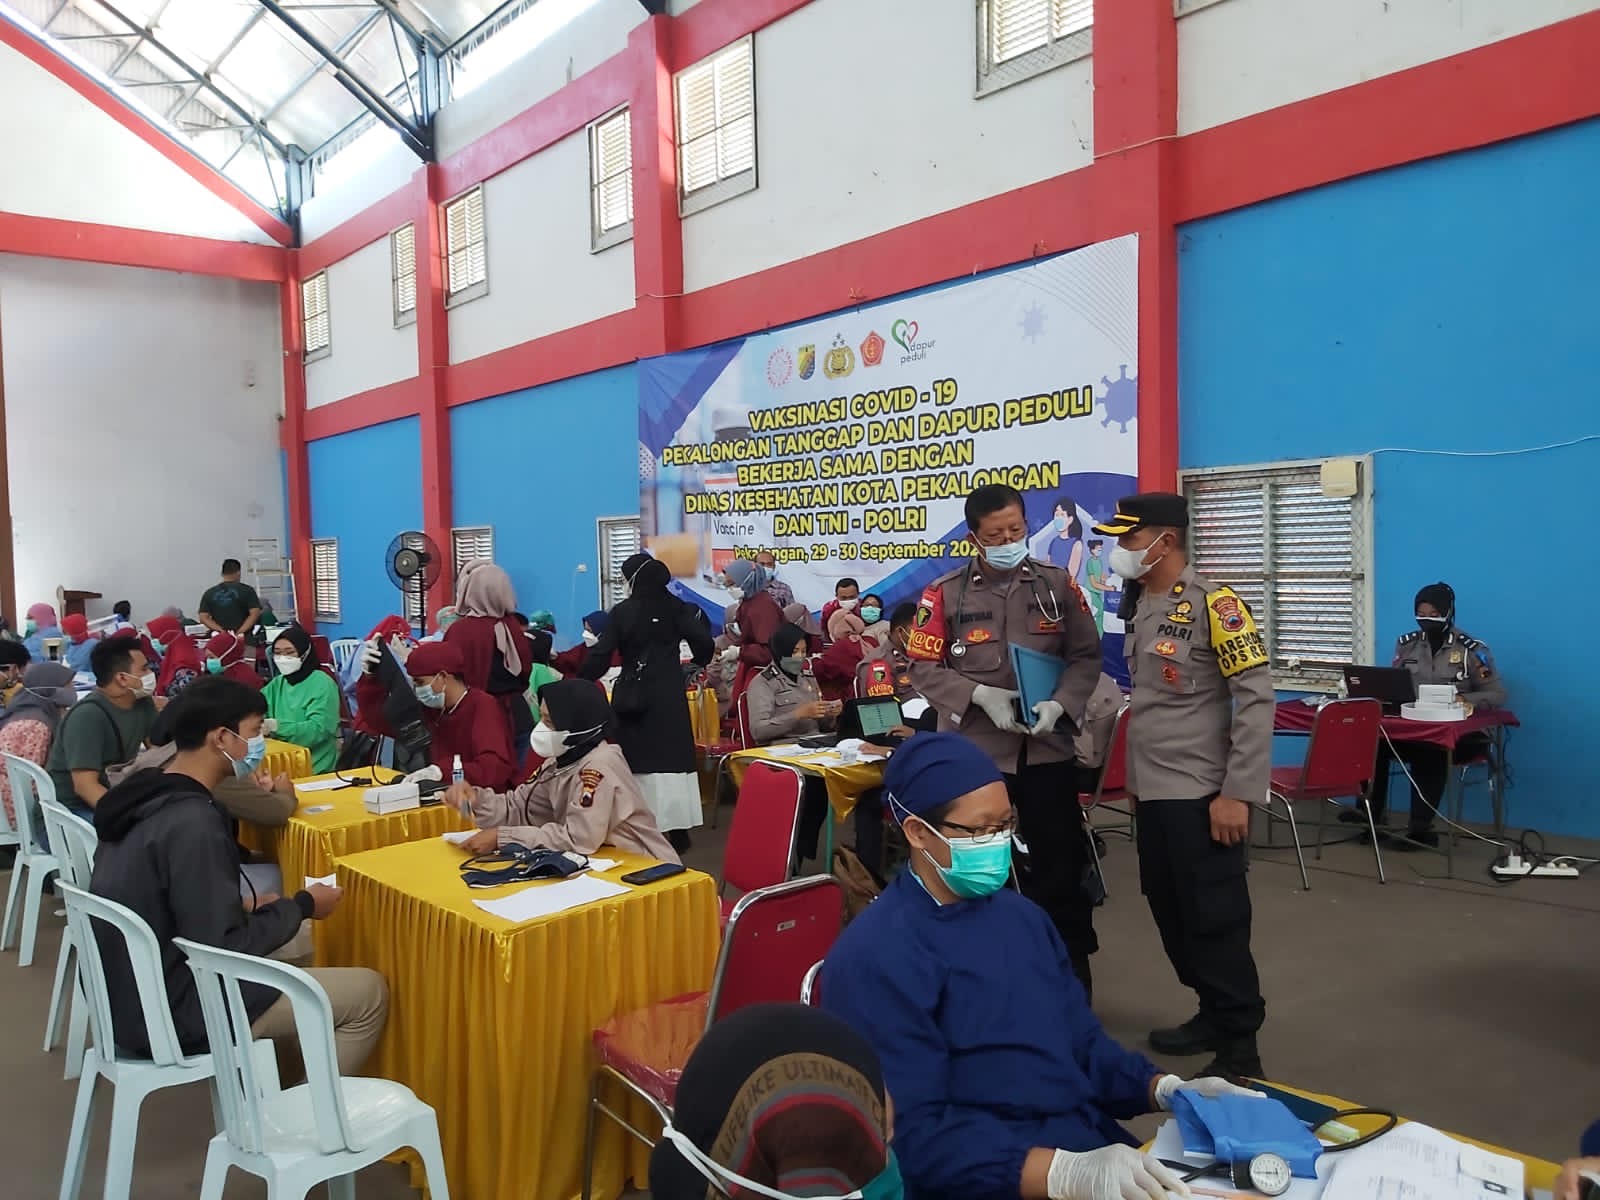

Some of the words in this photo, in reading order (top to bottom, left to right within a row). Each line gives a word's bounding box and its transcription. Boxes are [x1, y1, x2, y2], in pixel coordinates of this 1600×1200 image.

[910, 339, 936, 353] dapur
[900, 351, 926, 367] peduli
[749, 396, 847, 432] VAKSINASI
[850, 386, 916, 417] COVID
[933, 378, 957, 405] 19
[663, 437, 770, 465] PEKALONGAN
[775, 424, 864, 455] TANGGAP
[869, 416, 913, 445] DAN
[919, 404, 1000, 438] DAPUR
[1005, 385, 1093, 427] PEDULI
[737, 458, 816, 486] BEKERJA
[820, 452, 877, 478] SAMA
[881, 439, 974, 473] DENGAN
[685, 493, 730, 513] DINAS
[734, 486, 838, 512] KESEHATAN
[843, 479, 898, 506] KOTA
[902, 461, 1060, 501] PEKALONGAN
[713, 519, 755, 536] Vaccine
[773, 514, 812, 536] DAN
[817, 512, 849, 534] TNI
[864, 506, 927, 532] POLRI
[735, 545, 809, 564] Pekangan,
[811, 544, 828, 560] 29
[839, 543, 857, 560] 30
[860, 540, 946, 563] September
[1157, 623, 1193, 641] POLRI
[1221, 649, 1249, 670] OPS
